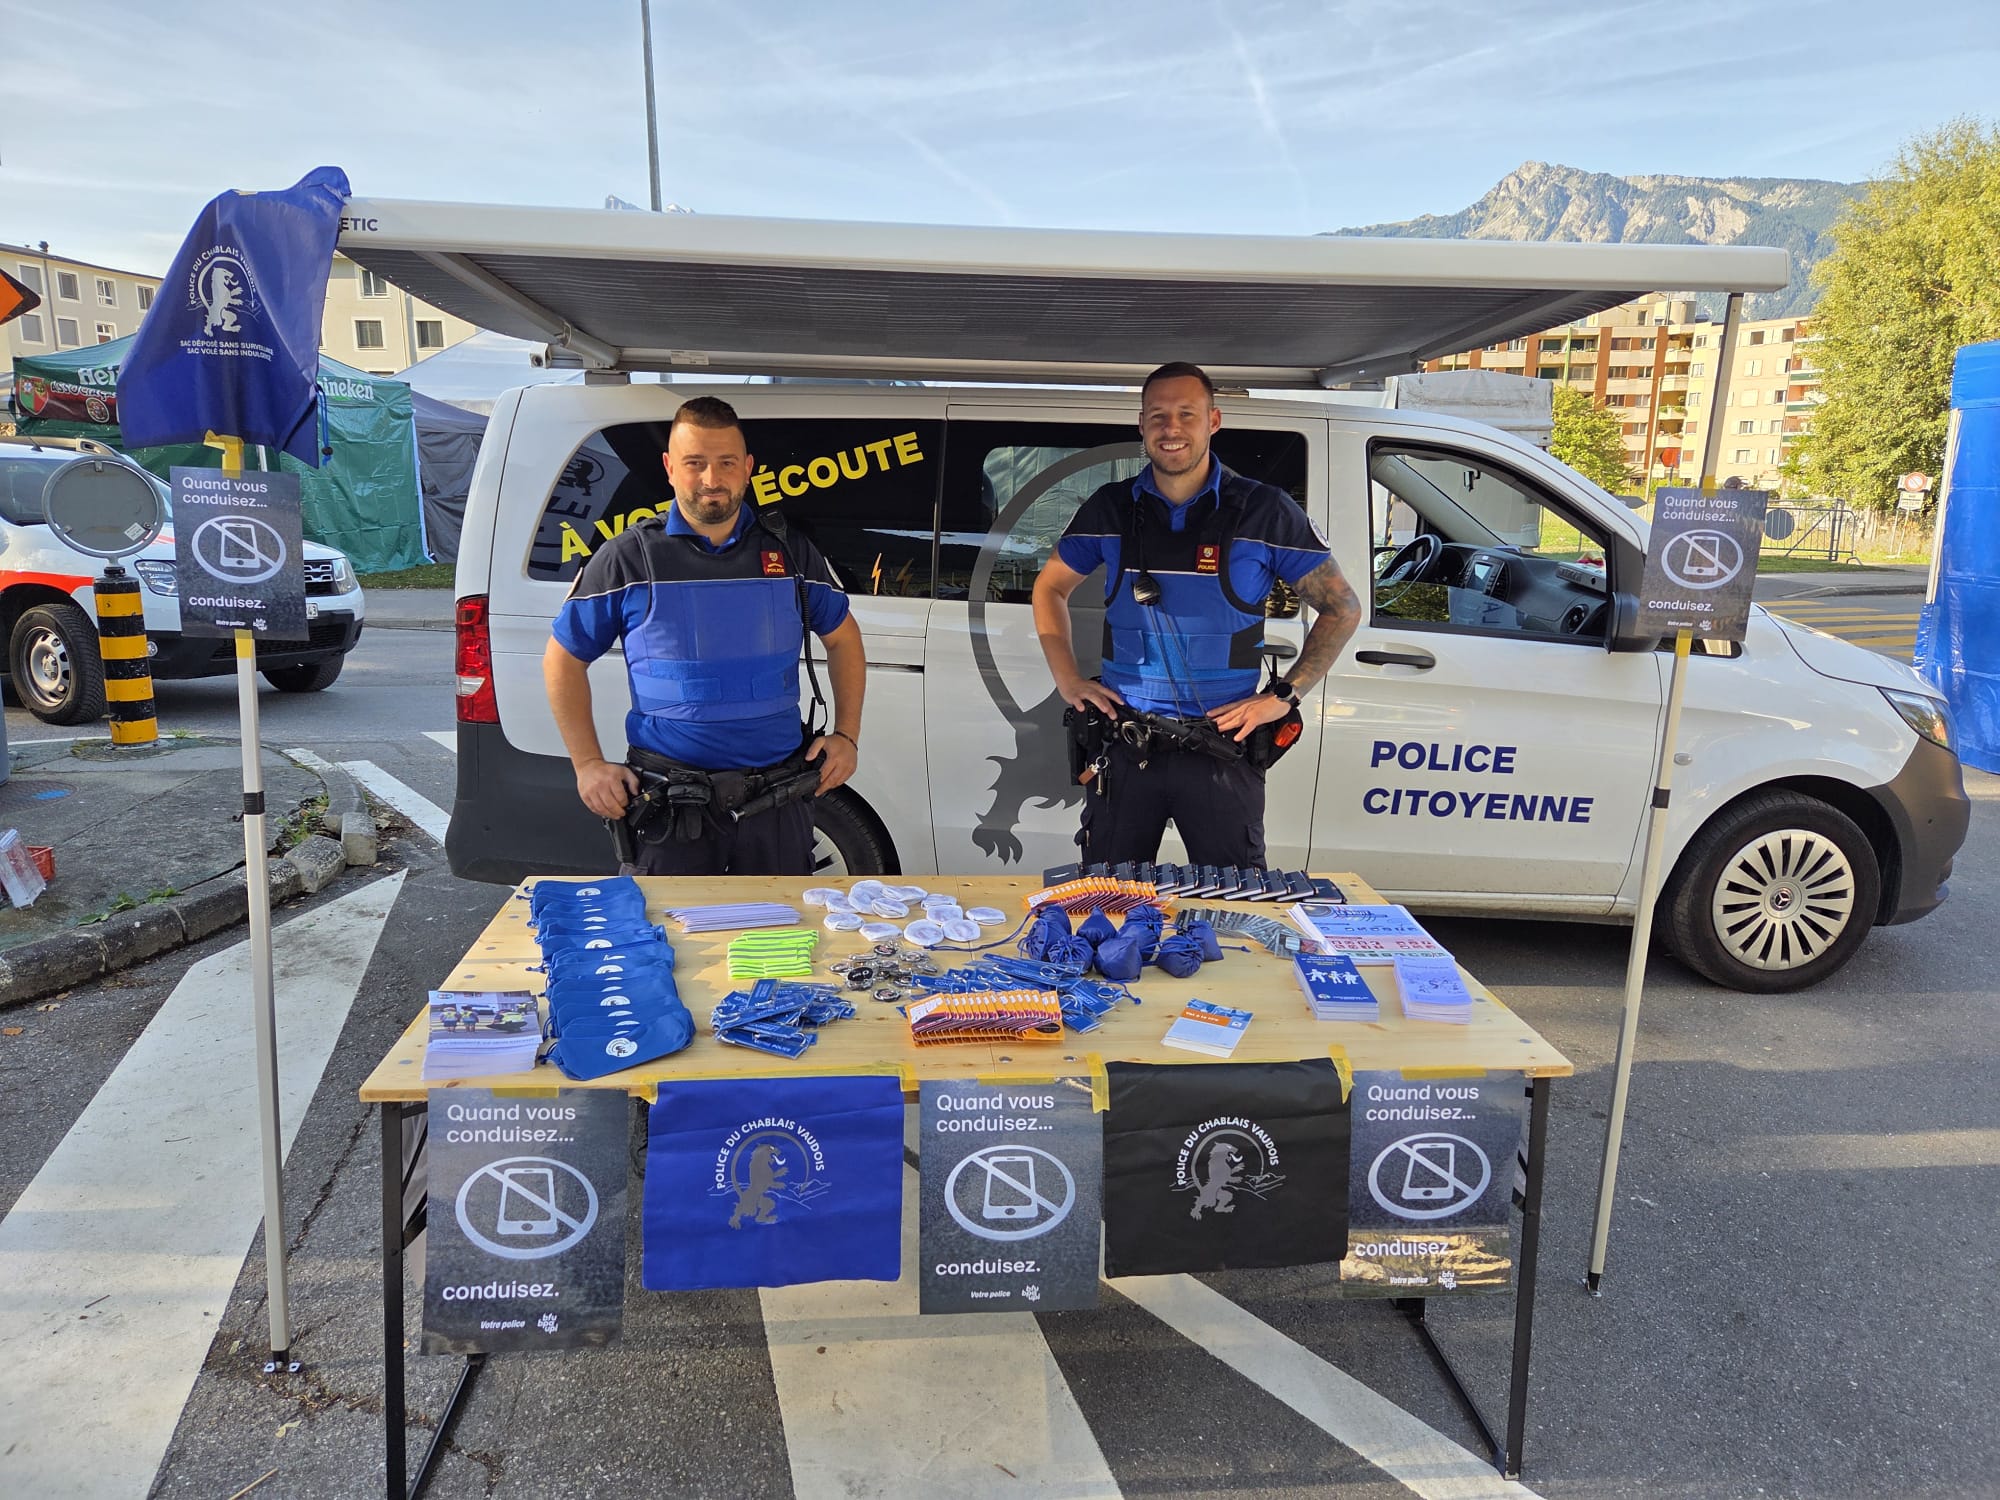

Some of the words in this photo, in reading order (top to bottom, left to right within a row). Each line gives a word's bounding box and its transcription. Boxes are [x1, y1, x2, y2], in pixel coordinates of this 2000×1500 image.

[339, 217, 379, 232] ETIC
[193, 258, 202, 271] DU
[219, 340, 239, 348] SANS
[219, 348, 239, 356] SANS
[78, 366, 120, 386] Hei
[317, 377, 374, 400] ineken
[182, 476, 230, 491] Quand
[234, 481, 268, 493] vous
[182, 493, 268, 508] conduisez...
[560, 521, 592, 563] À
[751, 431, 924, 507] ÉCOUTE
[1664, 496, 1707, 508] Quand
[1709, 499, 1738, 509] vous
[1662, 510, 1735, 522] conduisez...
[188, 595, 267, 609] conduisez.
[1648, 599, 1714, 612] conduisez.
[1370, 740, 1517, 774] POLICE
[1362, 788, 1594, 824] CITOYENNE
[1367, 1084, 1431, 1102] Quand
[1435, 1087, 1480, 1100] vous
[936, 1093, 1003, 1112] Quand
[1007, 1095, 1055, 1110] vous
[447, 1104, 520, 1122] Quand
[525, 1107, 576, 1121] vous
[1366, 1105, 1476, 1121] conduisez...
[936, 1114, 1053, 1132] conduisez...
[446, 1126, 574, 1143] conduisez...
[715, 1147, 730, 1189] POLICE
[725, 1130, 741, 1148] DU
[741, 1117, 796, 1134] CHABLAIS
[797, 1125, 825, 1172] VAUDOIS
[1176, 1148, 1190, 1186] POLICE
[1184, 1130, 1199, 1148] DU
[1198, 1116, 1250, 1133] CHABLAIS
[1251, 1123, 1279, 1166] VAUDOIS
[935, 1258, 1041, 1276] conduisez.
[442, 1280, 559, 1300] conduisez.
[970, 1290, 989, 1298] Votre
[989, 1290, 1011, 1299] police
[480, 1320, 500, 1329] Votre
[501, 1319, 526, 1330] police
